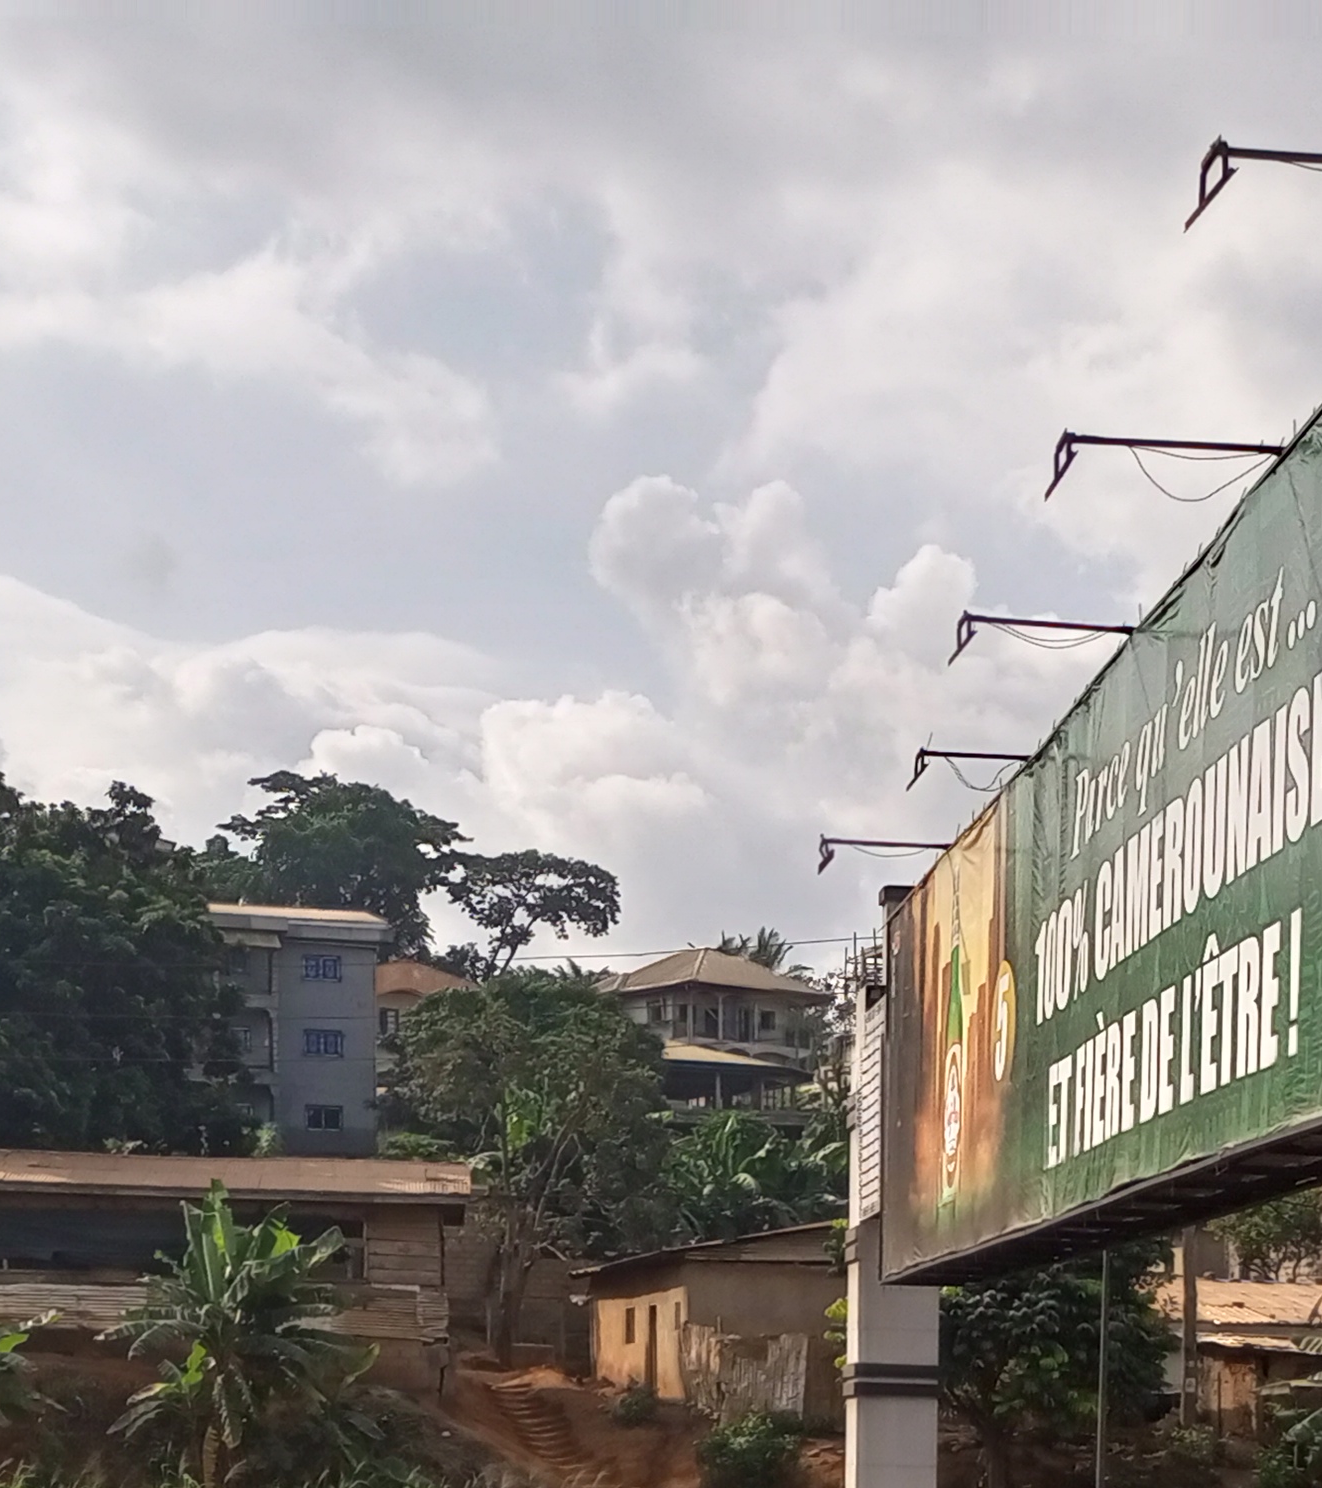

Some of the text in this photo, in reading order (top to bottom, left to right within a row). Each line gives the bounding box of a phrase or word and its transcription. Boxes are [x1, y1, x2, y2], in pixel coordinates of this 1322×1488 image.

[1070, 741, 1130, 860] Parce
[1034, 878, 1088, 1026] 100%
[1043, 1054, 1073, 1171] ET
[1073, 1011, 1137, 1158] FIÈRE
[1139, 985, 1176, 1124] DE
